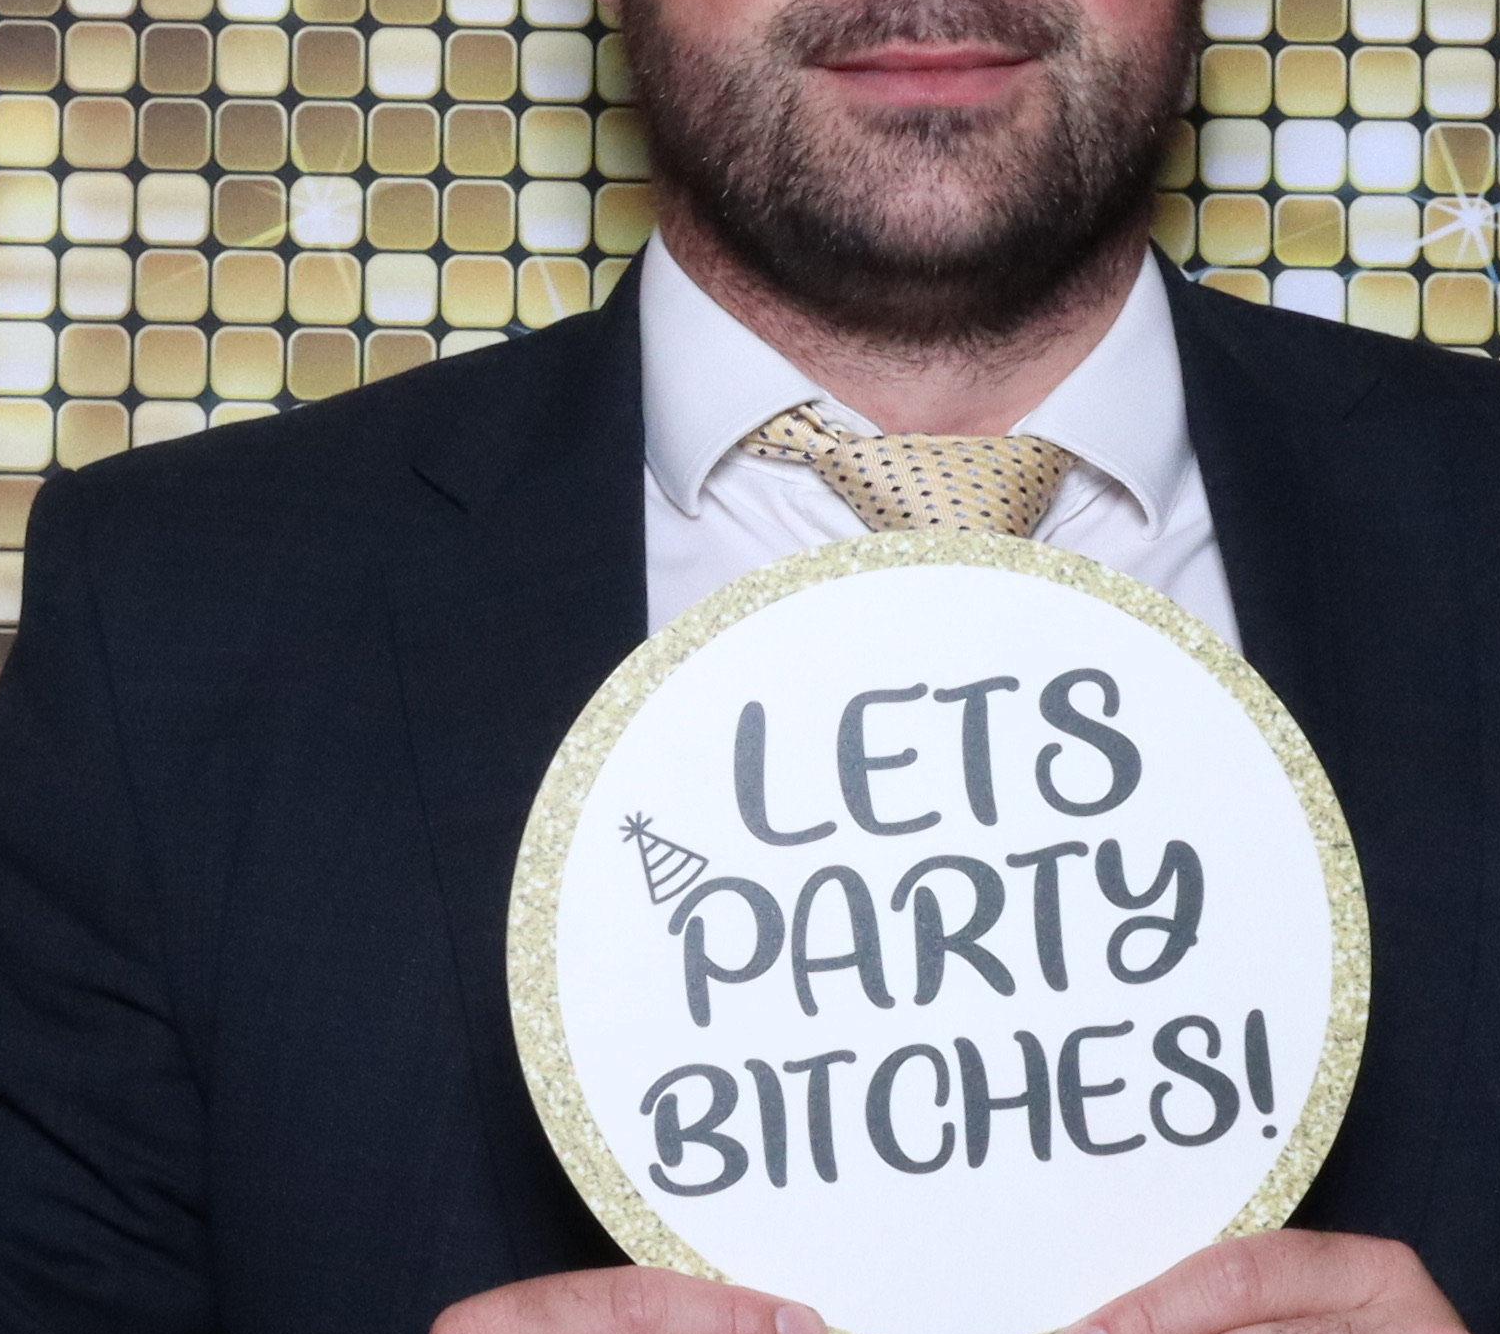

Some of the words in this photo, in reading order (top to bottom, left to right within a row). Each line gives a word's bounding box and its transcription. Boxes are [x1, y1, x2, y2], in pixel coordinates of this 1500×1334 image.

[733, 668, 1142, 847] LETS
[668, 838, 1205, 1028] PARTY
[639, 1008, 1278, 1197] BITCHES!
